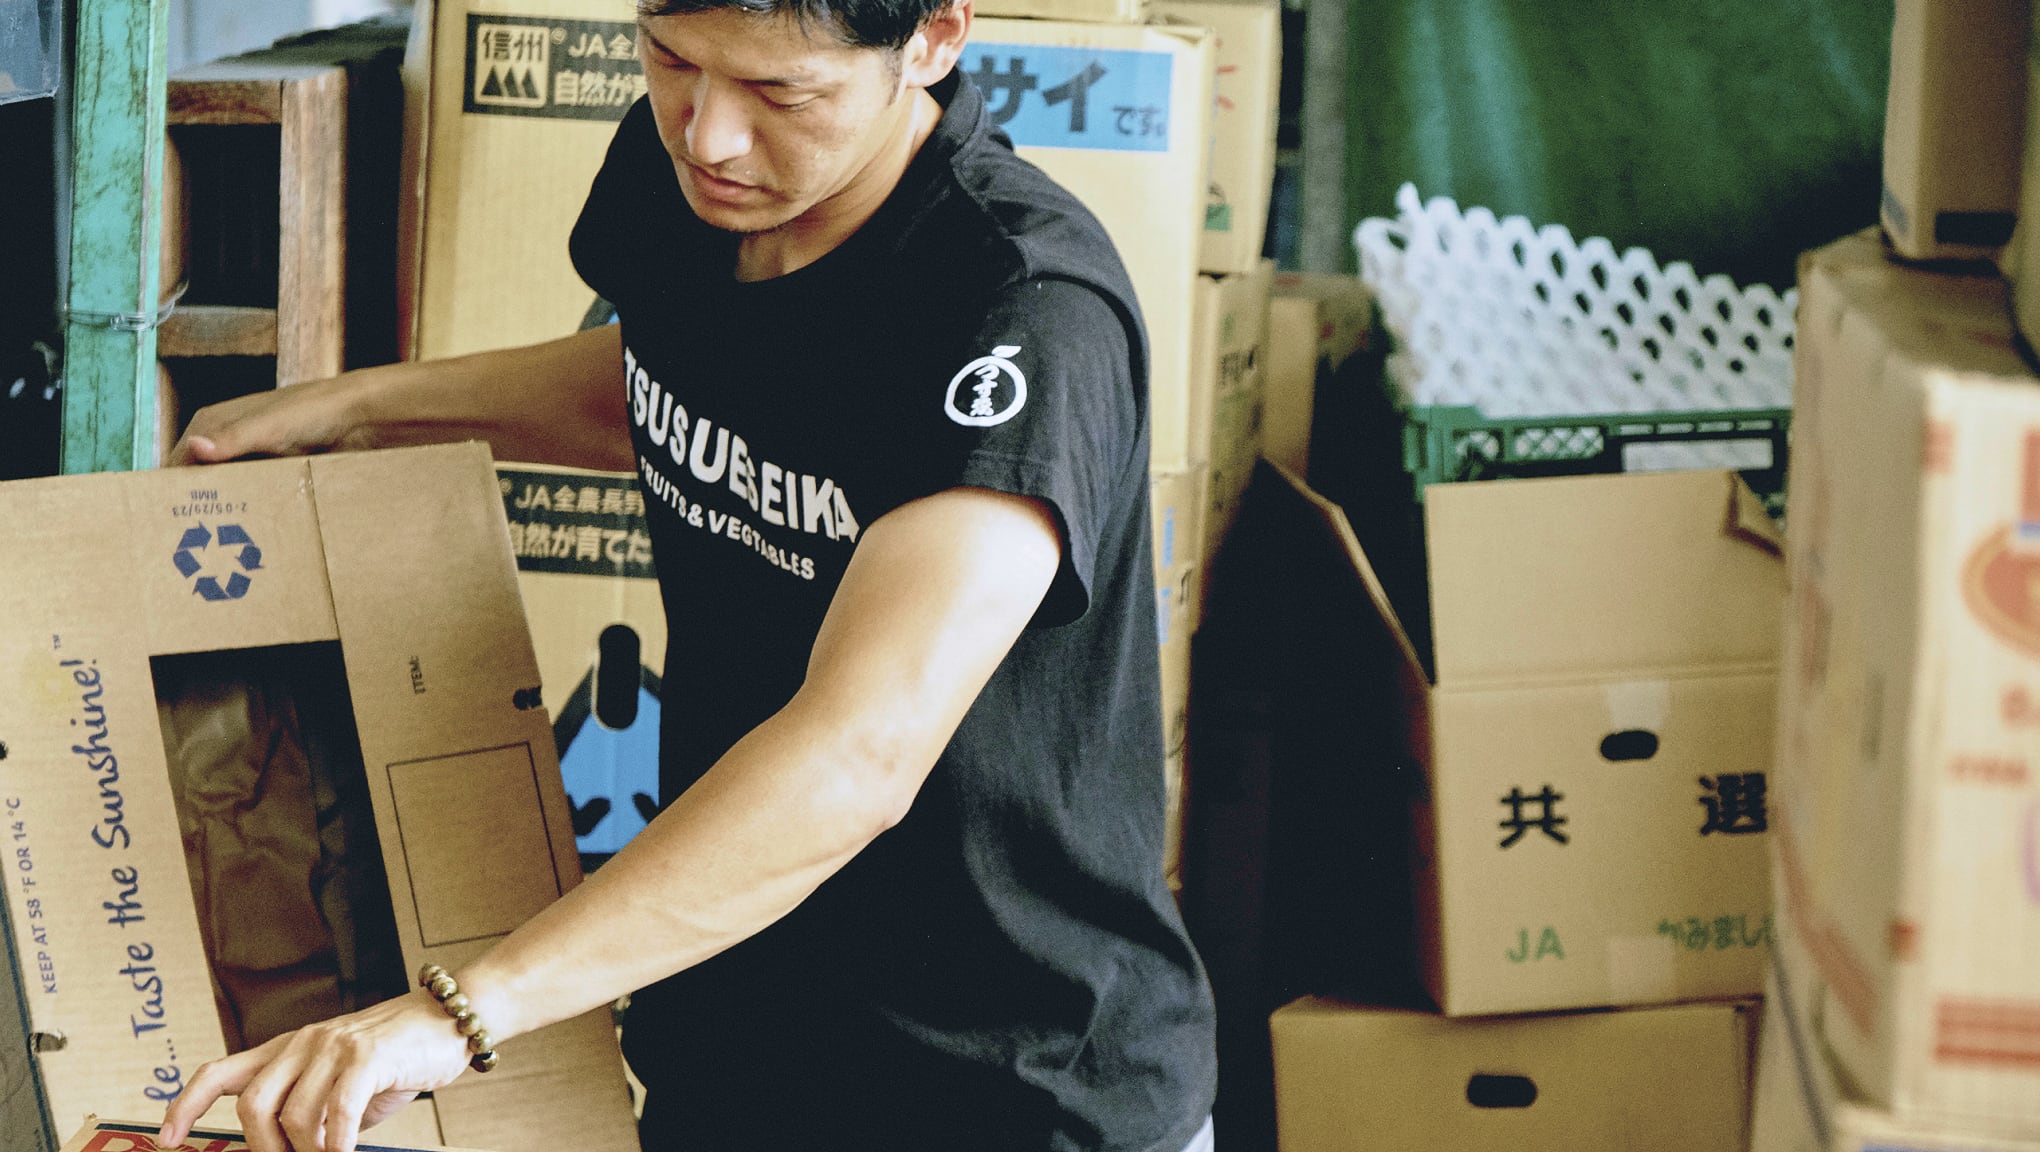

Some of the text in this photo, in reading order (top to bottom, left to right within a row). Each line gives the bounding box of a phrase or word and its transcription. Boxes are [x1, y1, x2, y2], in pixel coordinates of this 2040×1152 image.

[483, 30, 544, 62] 信州
[568, 32, 641, 60] JA全
[11, 820, 27, 841] 14
[1499, 784, 1568, 849] 共
[16, 847, 33, 872] OR
[26, 898, 43, 919] 58
[103, 865, 146, 929] the
[31, 924, 49, 946] AT
[1505, 927, 1566, 962] JA
[37, 950, 58, 994] KEEP
